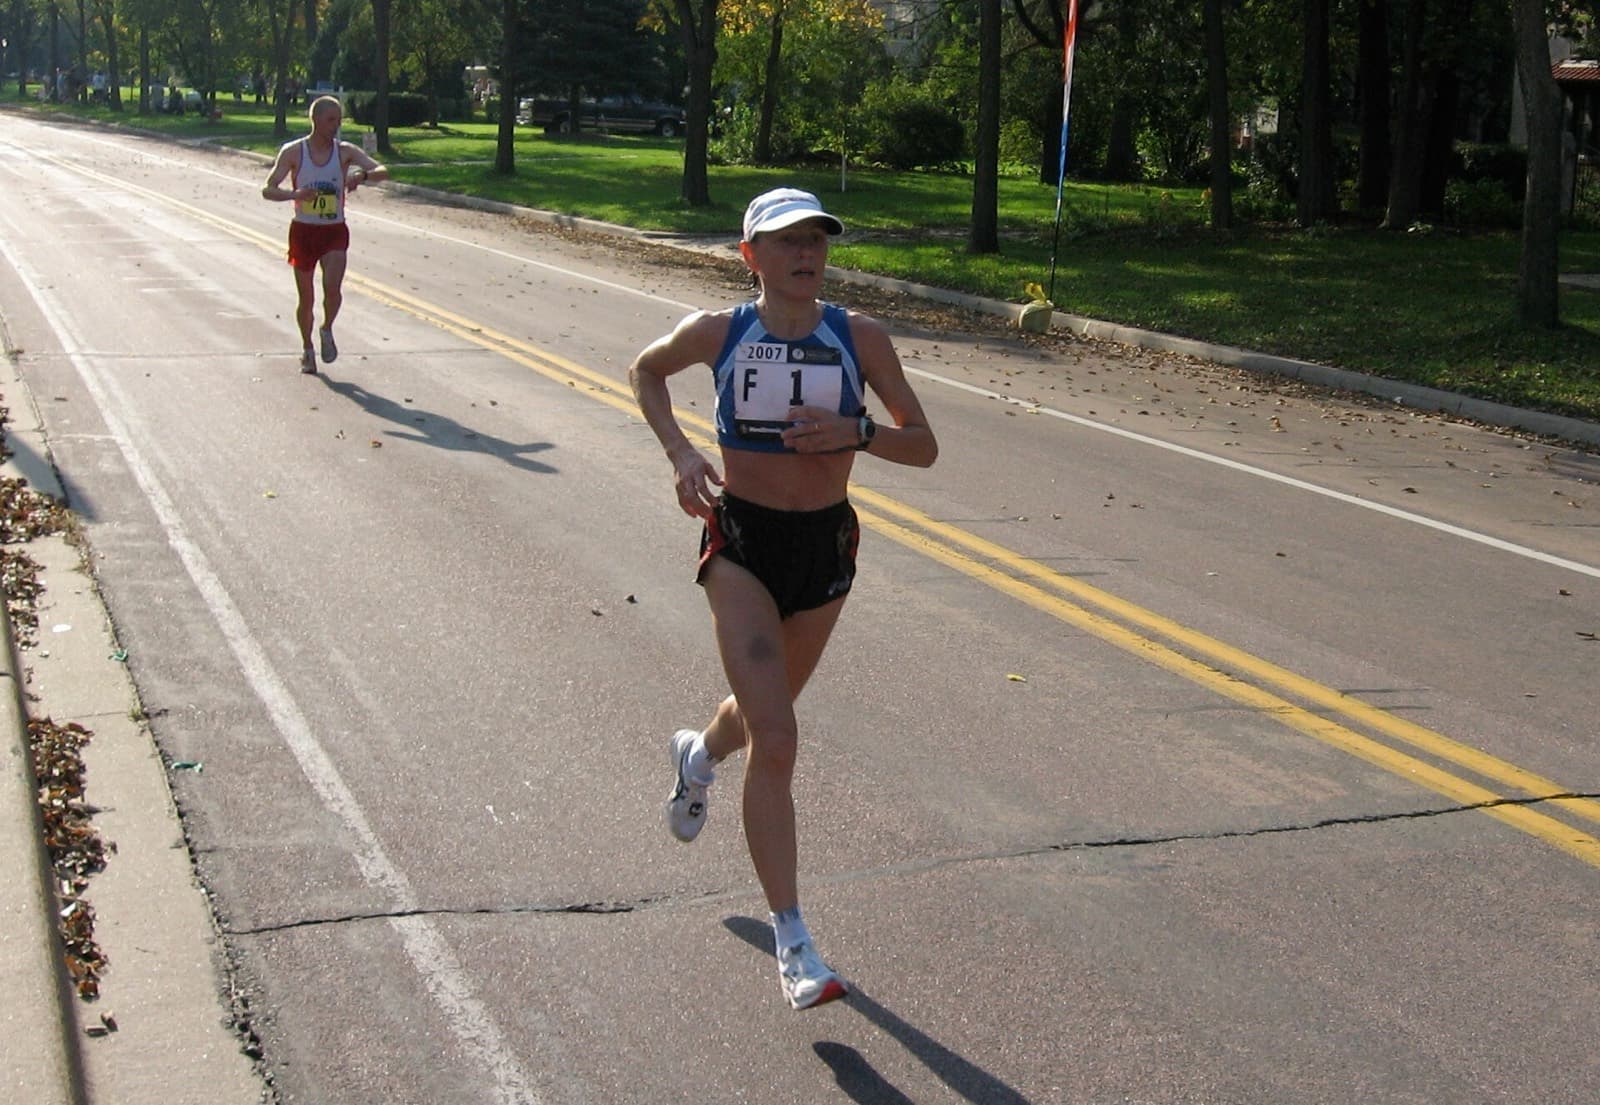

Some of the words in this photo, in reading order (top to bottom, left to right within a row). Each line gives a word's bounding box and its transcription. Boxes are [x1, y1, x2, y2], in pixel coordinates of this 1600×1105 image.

[747, 346, 782, 360] 2007
[743, 368, 758, 402] F
[789, 369, 804, 406] 1
